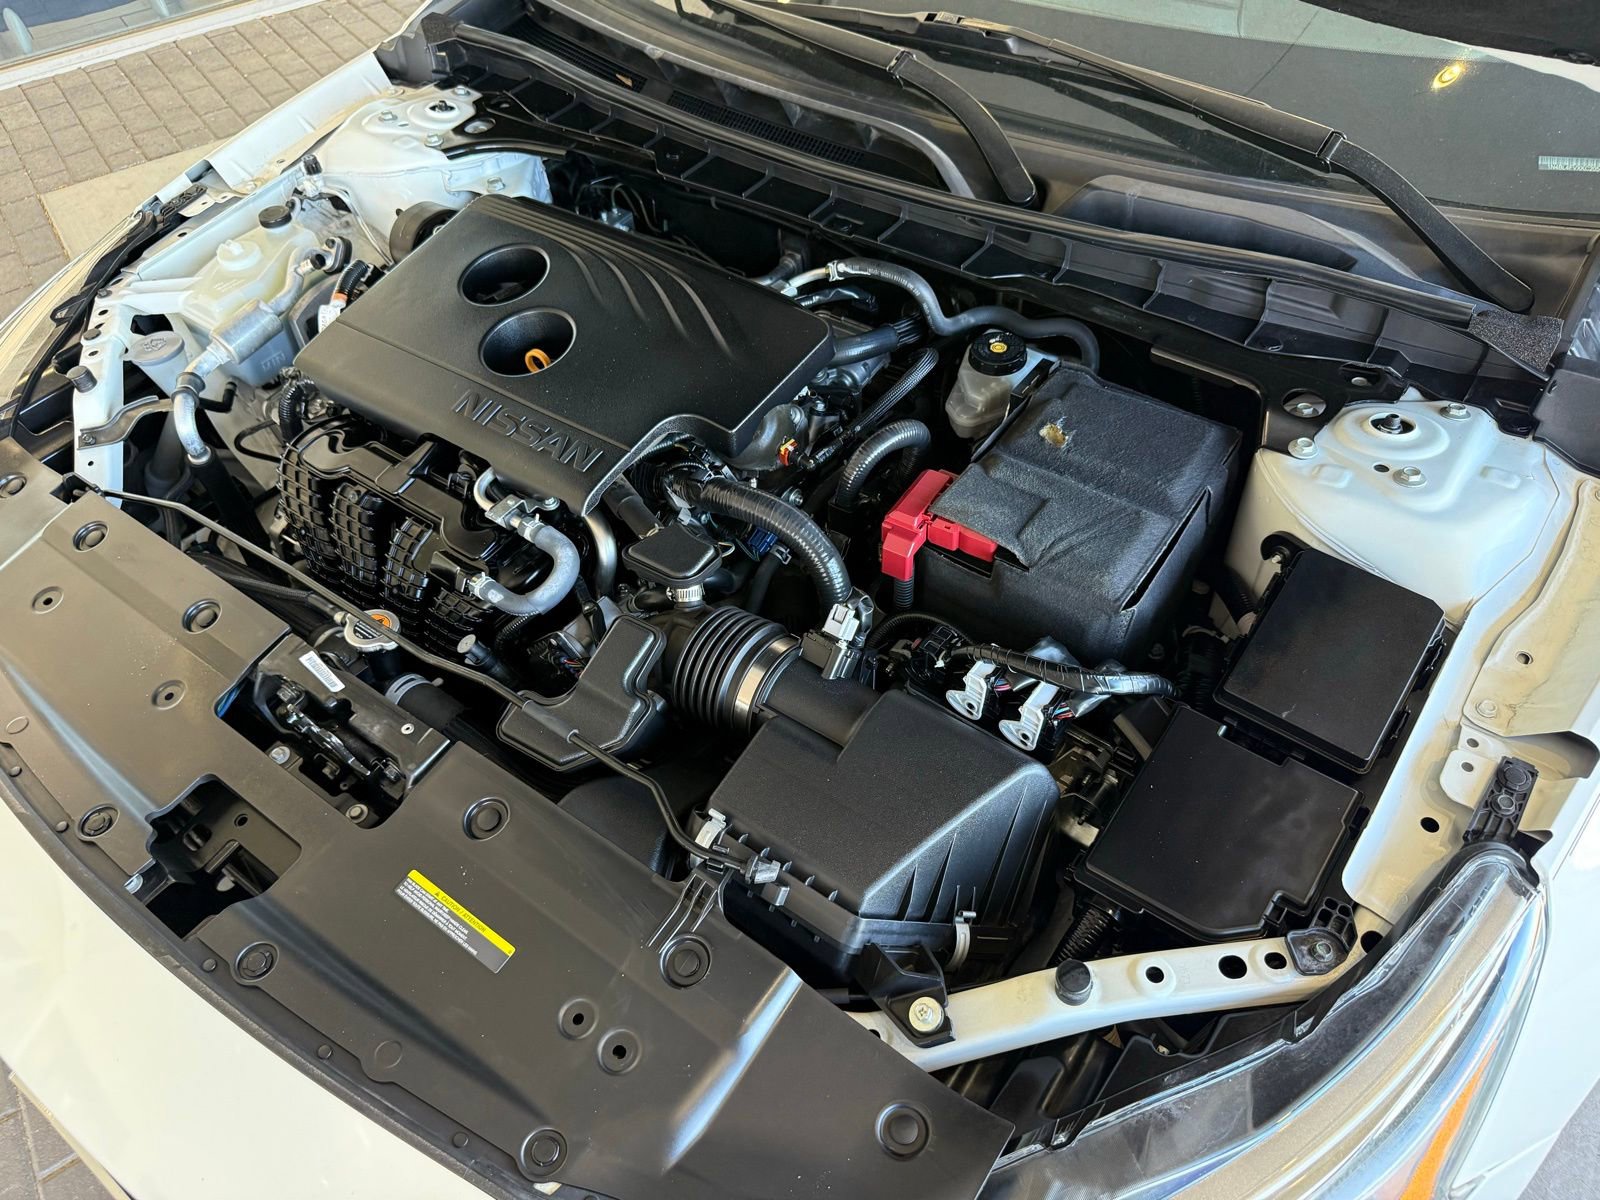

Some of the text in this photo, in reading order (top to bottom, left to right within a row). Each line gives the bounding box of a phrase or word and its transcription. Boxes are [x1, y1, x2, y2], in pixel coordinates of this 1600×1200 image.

[451, 389, 603, 472] NISSAN
[441, 895, 461, 912] CAUTION
[462, 912, 486, 932] ATTENTION
